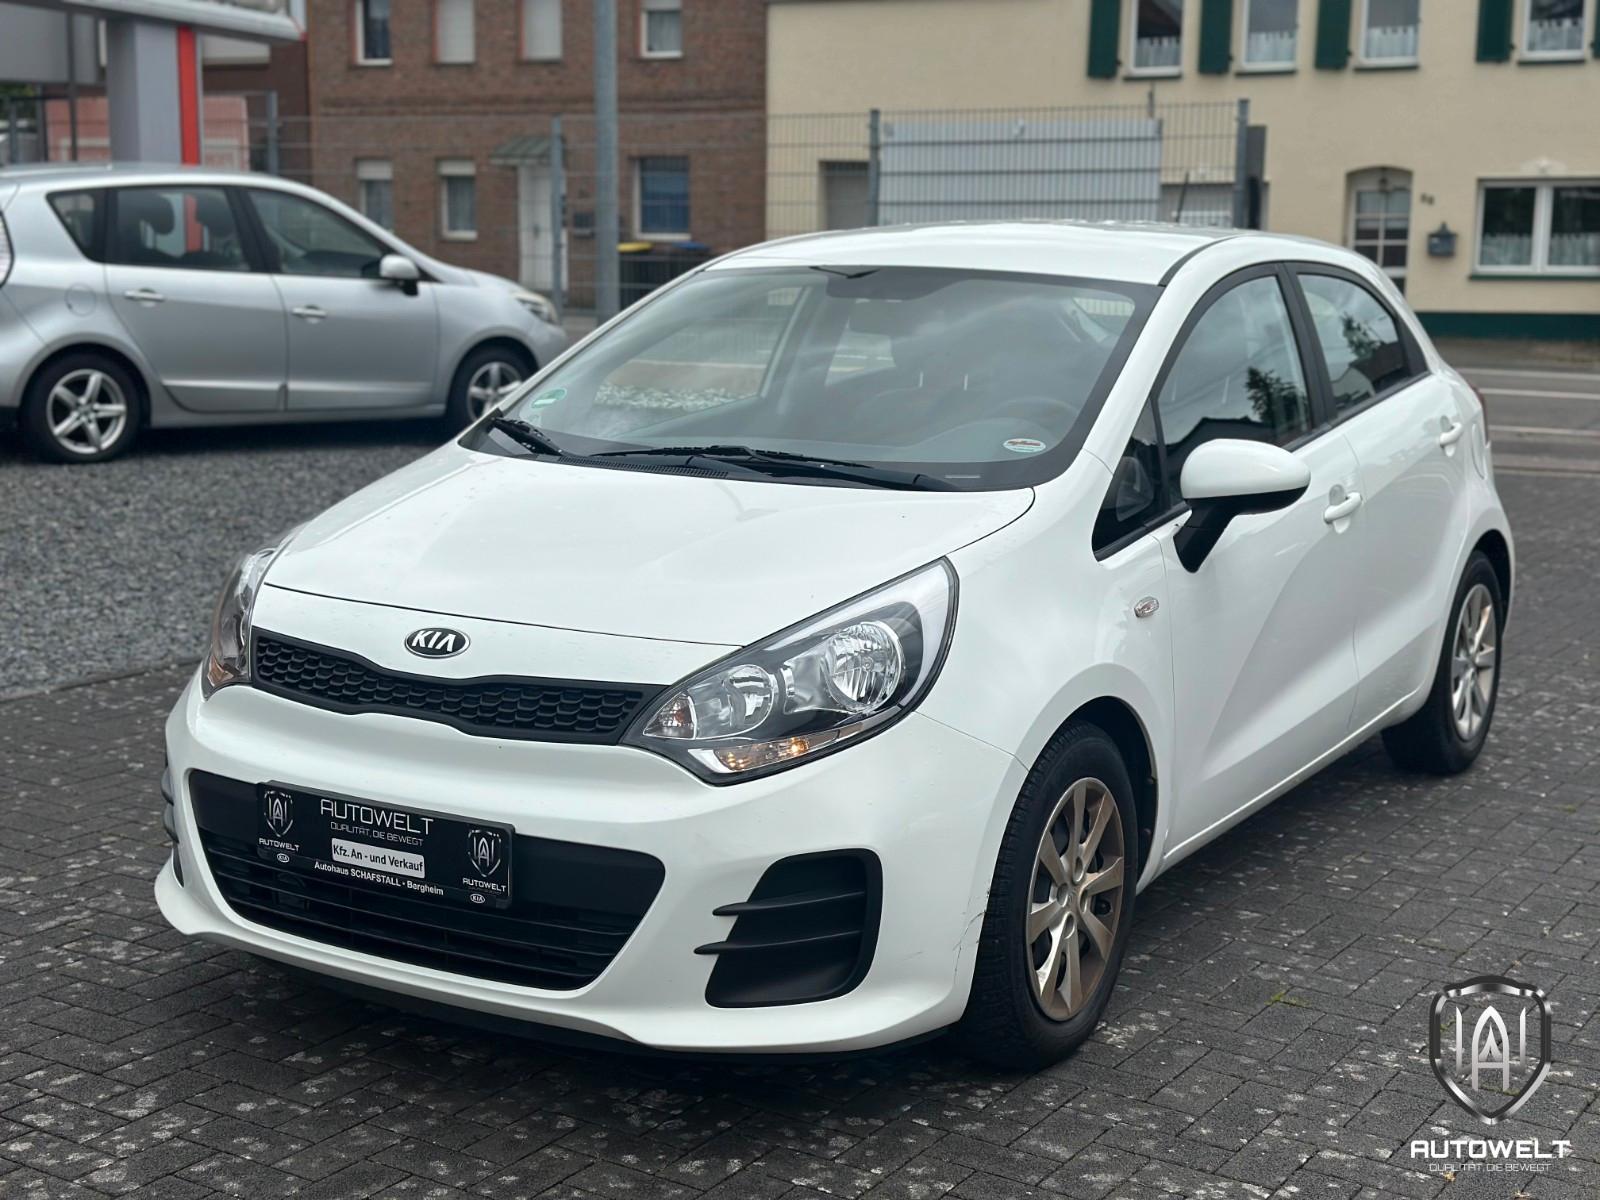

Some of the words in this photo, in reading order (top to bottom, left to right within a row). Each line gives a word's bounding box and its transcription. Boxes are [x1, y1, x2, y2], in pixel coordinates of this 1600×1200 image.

[411, 630, 457, 652] KIA
[320, 798, 434, 835] AUTOWELT
[258, 837, 299, 851] AUTOWELT
[386, 832, 424, 846] BEWEGT
[333, 844, 350, 857] Kfz.
[370, 855, 386, 865] und
[388, 856, 423, 872] Verkauf
[314, 861, 349, 875] Autohaus
[350, 868, 401, 887] SCHAFSTALL
[407, 880, 444, 896] Bergheim
[462, 877, 506, 892] AUTOWELT
